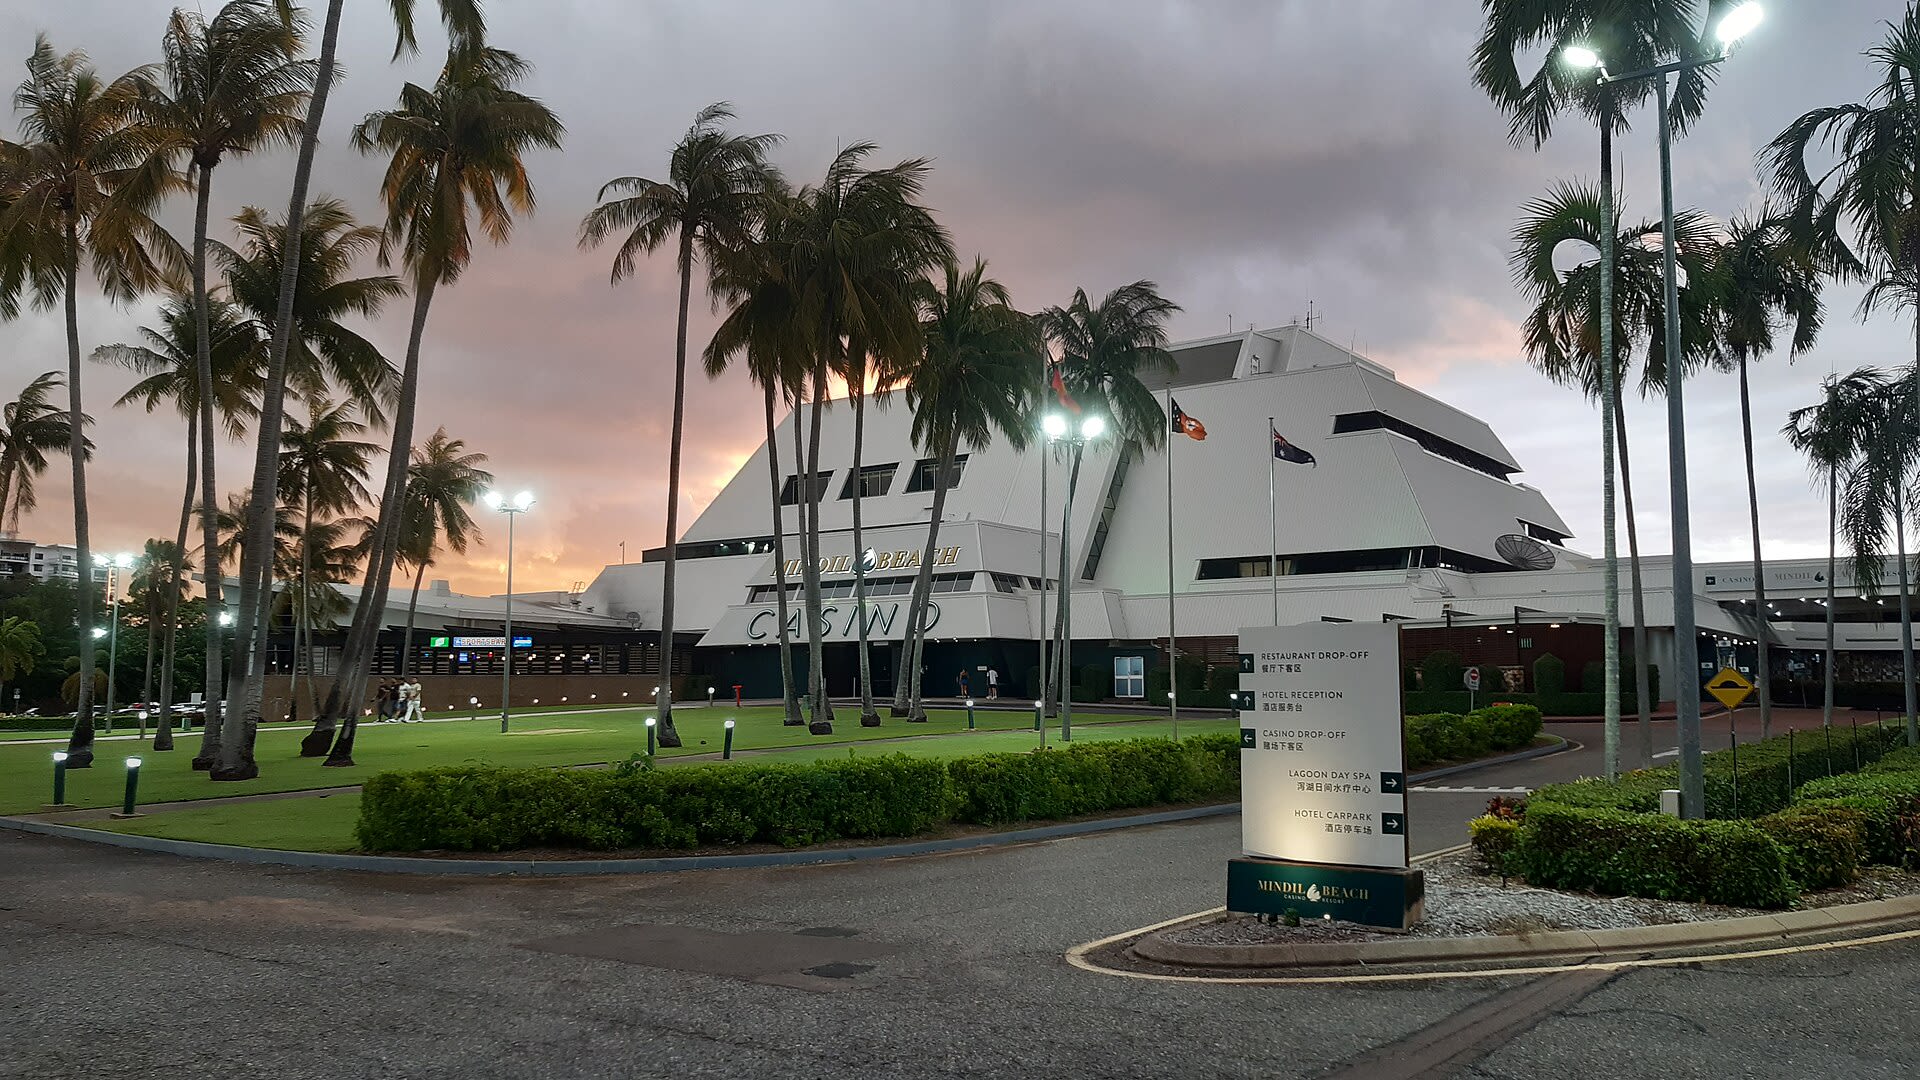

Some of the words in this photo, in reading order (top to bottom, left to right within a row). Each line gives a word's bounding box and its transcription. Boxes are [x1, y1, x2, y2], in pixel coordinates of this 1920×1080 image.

[769, 555, 851, 578] MIDIL
[1261, 651, 1315, 661] RESTAURANT
[1318, 651, 1369, 660] DROP-OFF
[1261, 663, 1302, 673] 餐厅下客区
[1262, 691, 1289, 699] HOTEL
[1291, 691, 1343, 699] RECEPTION
[1262, 702, 1303, 712] 酒店服务台
[1262, 729, 1295, 738] CASINO
[1297, 730, 1346, 739] DROP-OFF
[1289, 769, 1328, 778] LAGOON
[1331, 771, 1350, 779] DAY
[1353, 772, 1371, 780] SPA
[1294, 809, 1324, 819] HOTEL
[1326, 811, 1373, 821] CARPARK
[1325, 823, 1373, 835] 酒店停车场
[1258, 879, 1306, 895] MINDIL
[1322, 885, 1369, 900] BEACH
